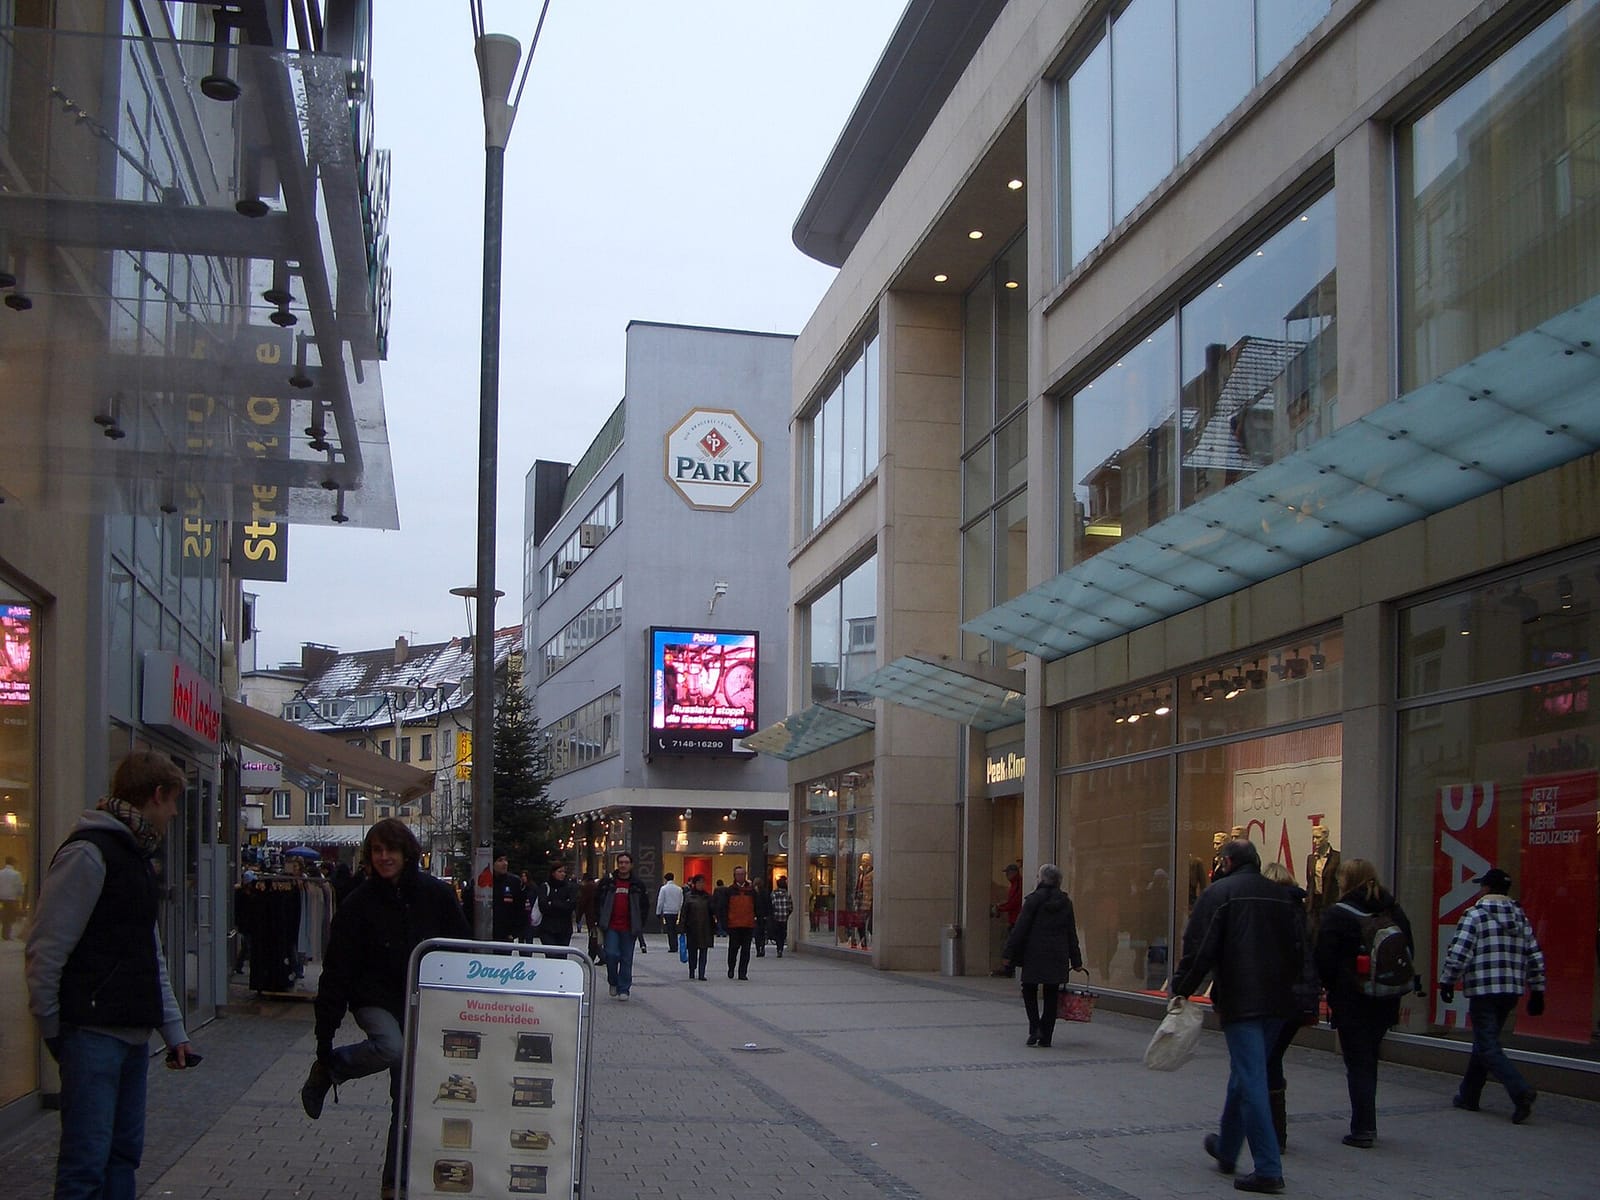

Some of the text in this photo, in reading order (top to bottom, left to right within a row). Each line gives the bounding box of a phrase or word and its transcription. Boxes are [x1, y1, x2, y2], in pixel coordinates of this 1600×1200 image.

[243, 343, 281, 561] Stret Oe
[676, 456, 752, 483] PARK
[672, 704, 745, 717] Russland stoppt
[666, 714, 680, 723] die
[242, 761, 281, 772] claire's
[1242, 780, 1308, 817] Designer
[1530, 786, 1560, 801] JETZT
[1529, 816, 1556, 830] MEHR
[1529, 830, 1581, 844] REDUZIERT
[466, 960, 537, 985] Douglas
[466, 1000, 534, 1013] Wundervolle
[459, 1011, 540, 1025] Geschenkideen
